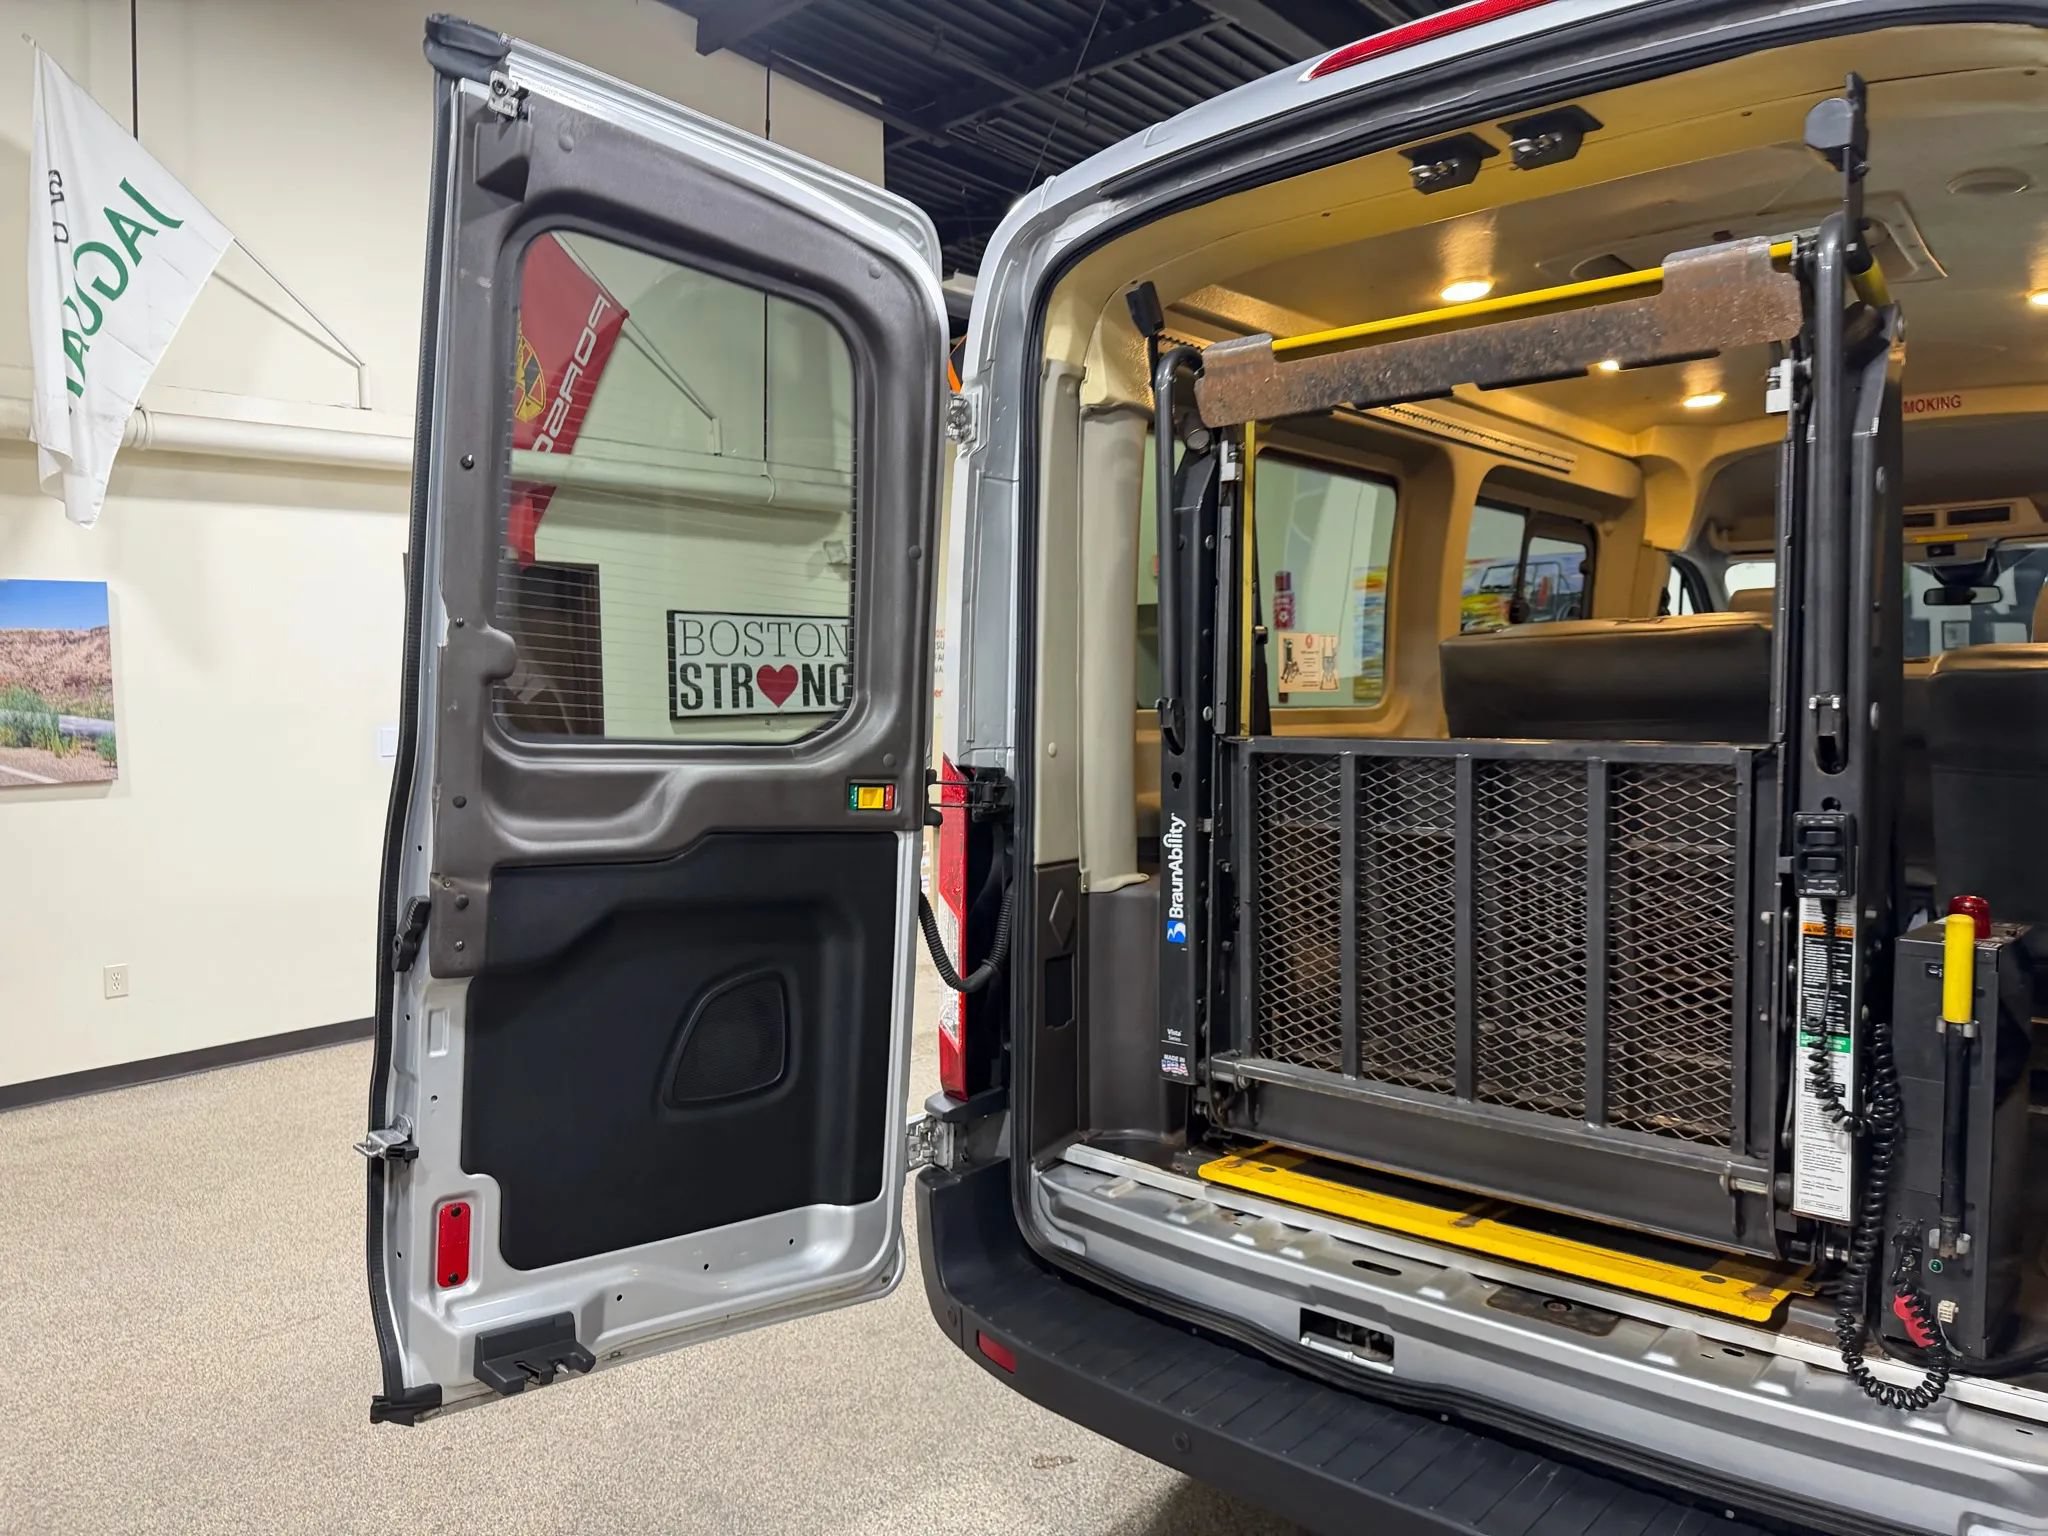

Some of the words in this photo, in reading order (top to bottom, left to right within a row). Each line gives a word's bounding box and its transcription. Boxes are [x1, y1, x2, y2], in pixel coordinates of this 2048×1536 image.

[678, 619, 849, 658] BOSTON
[1163, 814, 1187, 919] BraunAbility
[1161, 1059, 1189, 1077] USA
[1163, 1054, 1179, 1062] MADE
